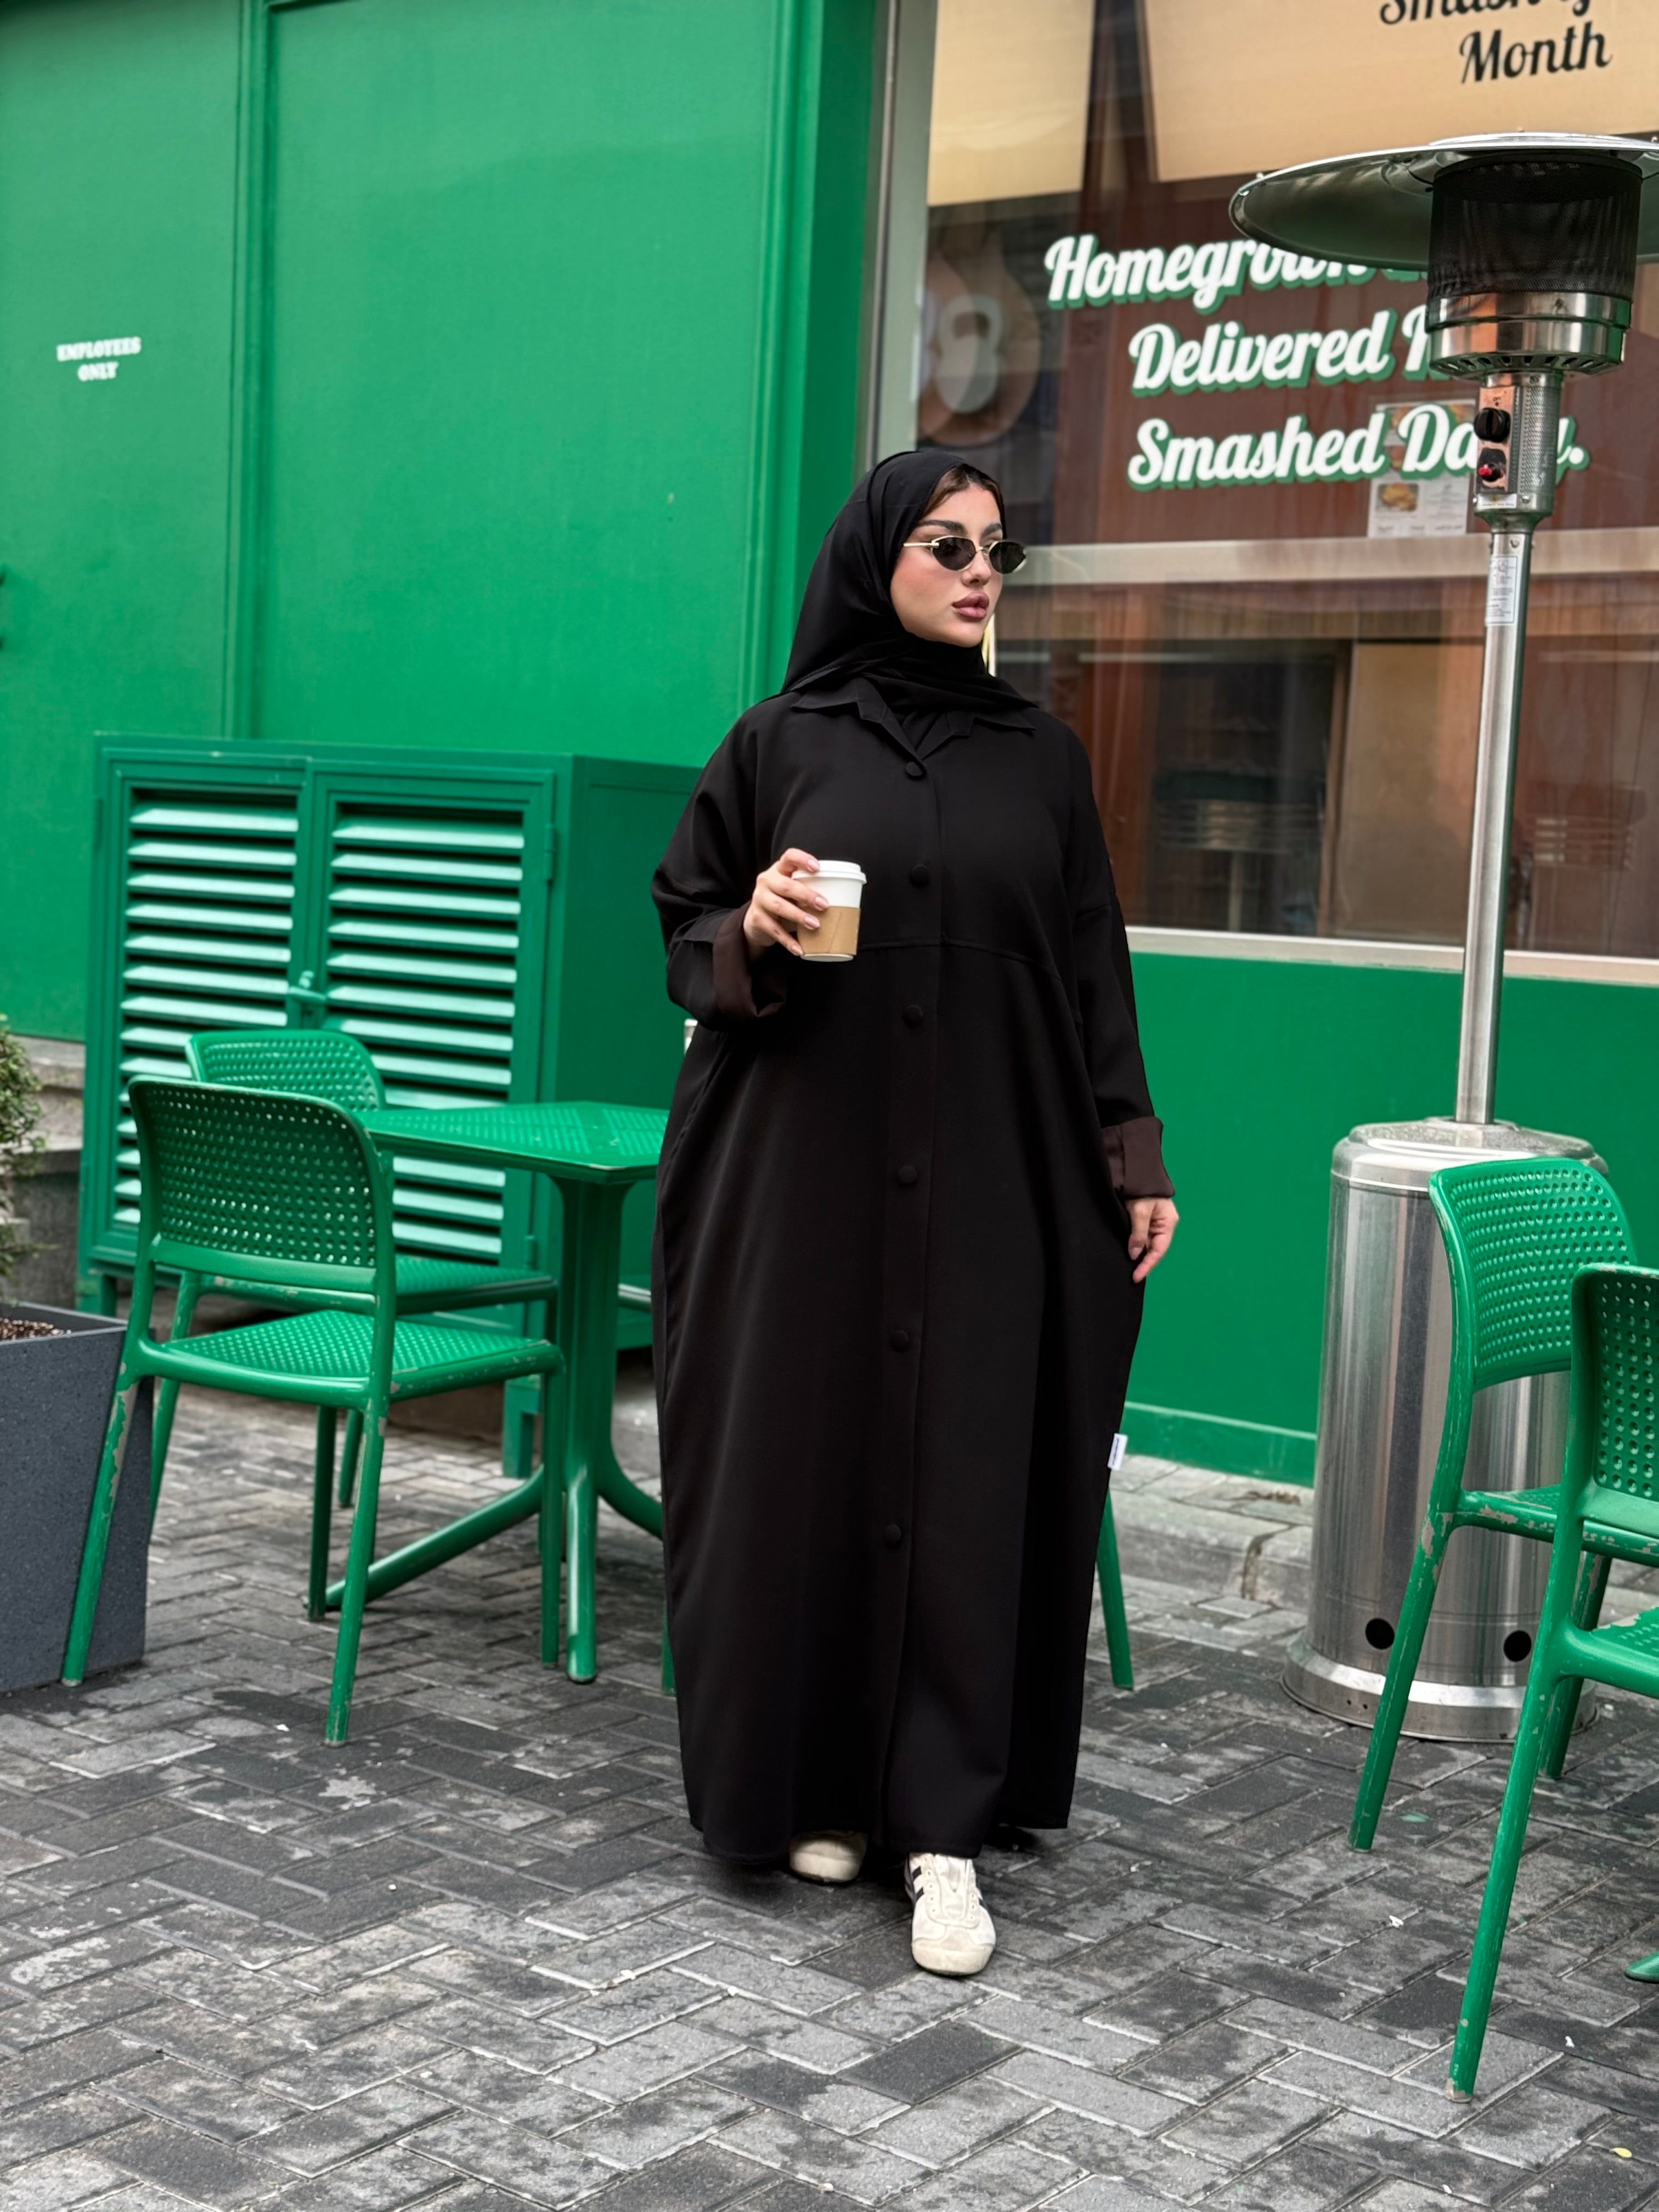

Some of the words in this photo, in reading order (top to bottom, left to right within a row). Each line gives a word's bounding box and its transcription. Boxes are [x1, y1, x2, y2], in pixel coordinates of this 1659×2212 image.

[1459, 20, 1613, 84] Month
[77, 360, 119, 382] ONLY
[1128, 310, 1391, 391] Delivered
[1127, 411, 1384, 485] Smashed
